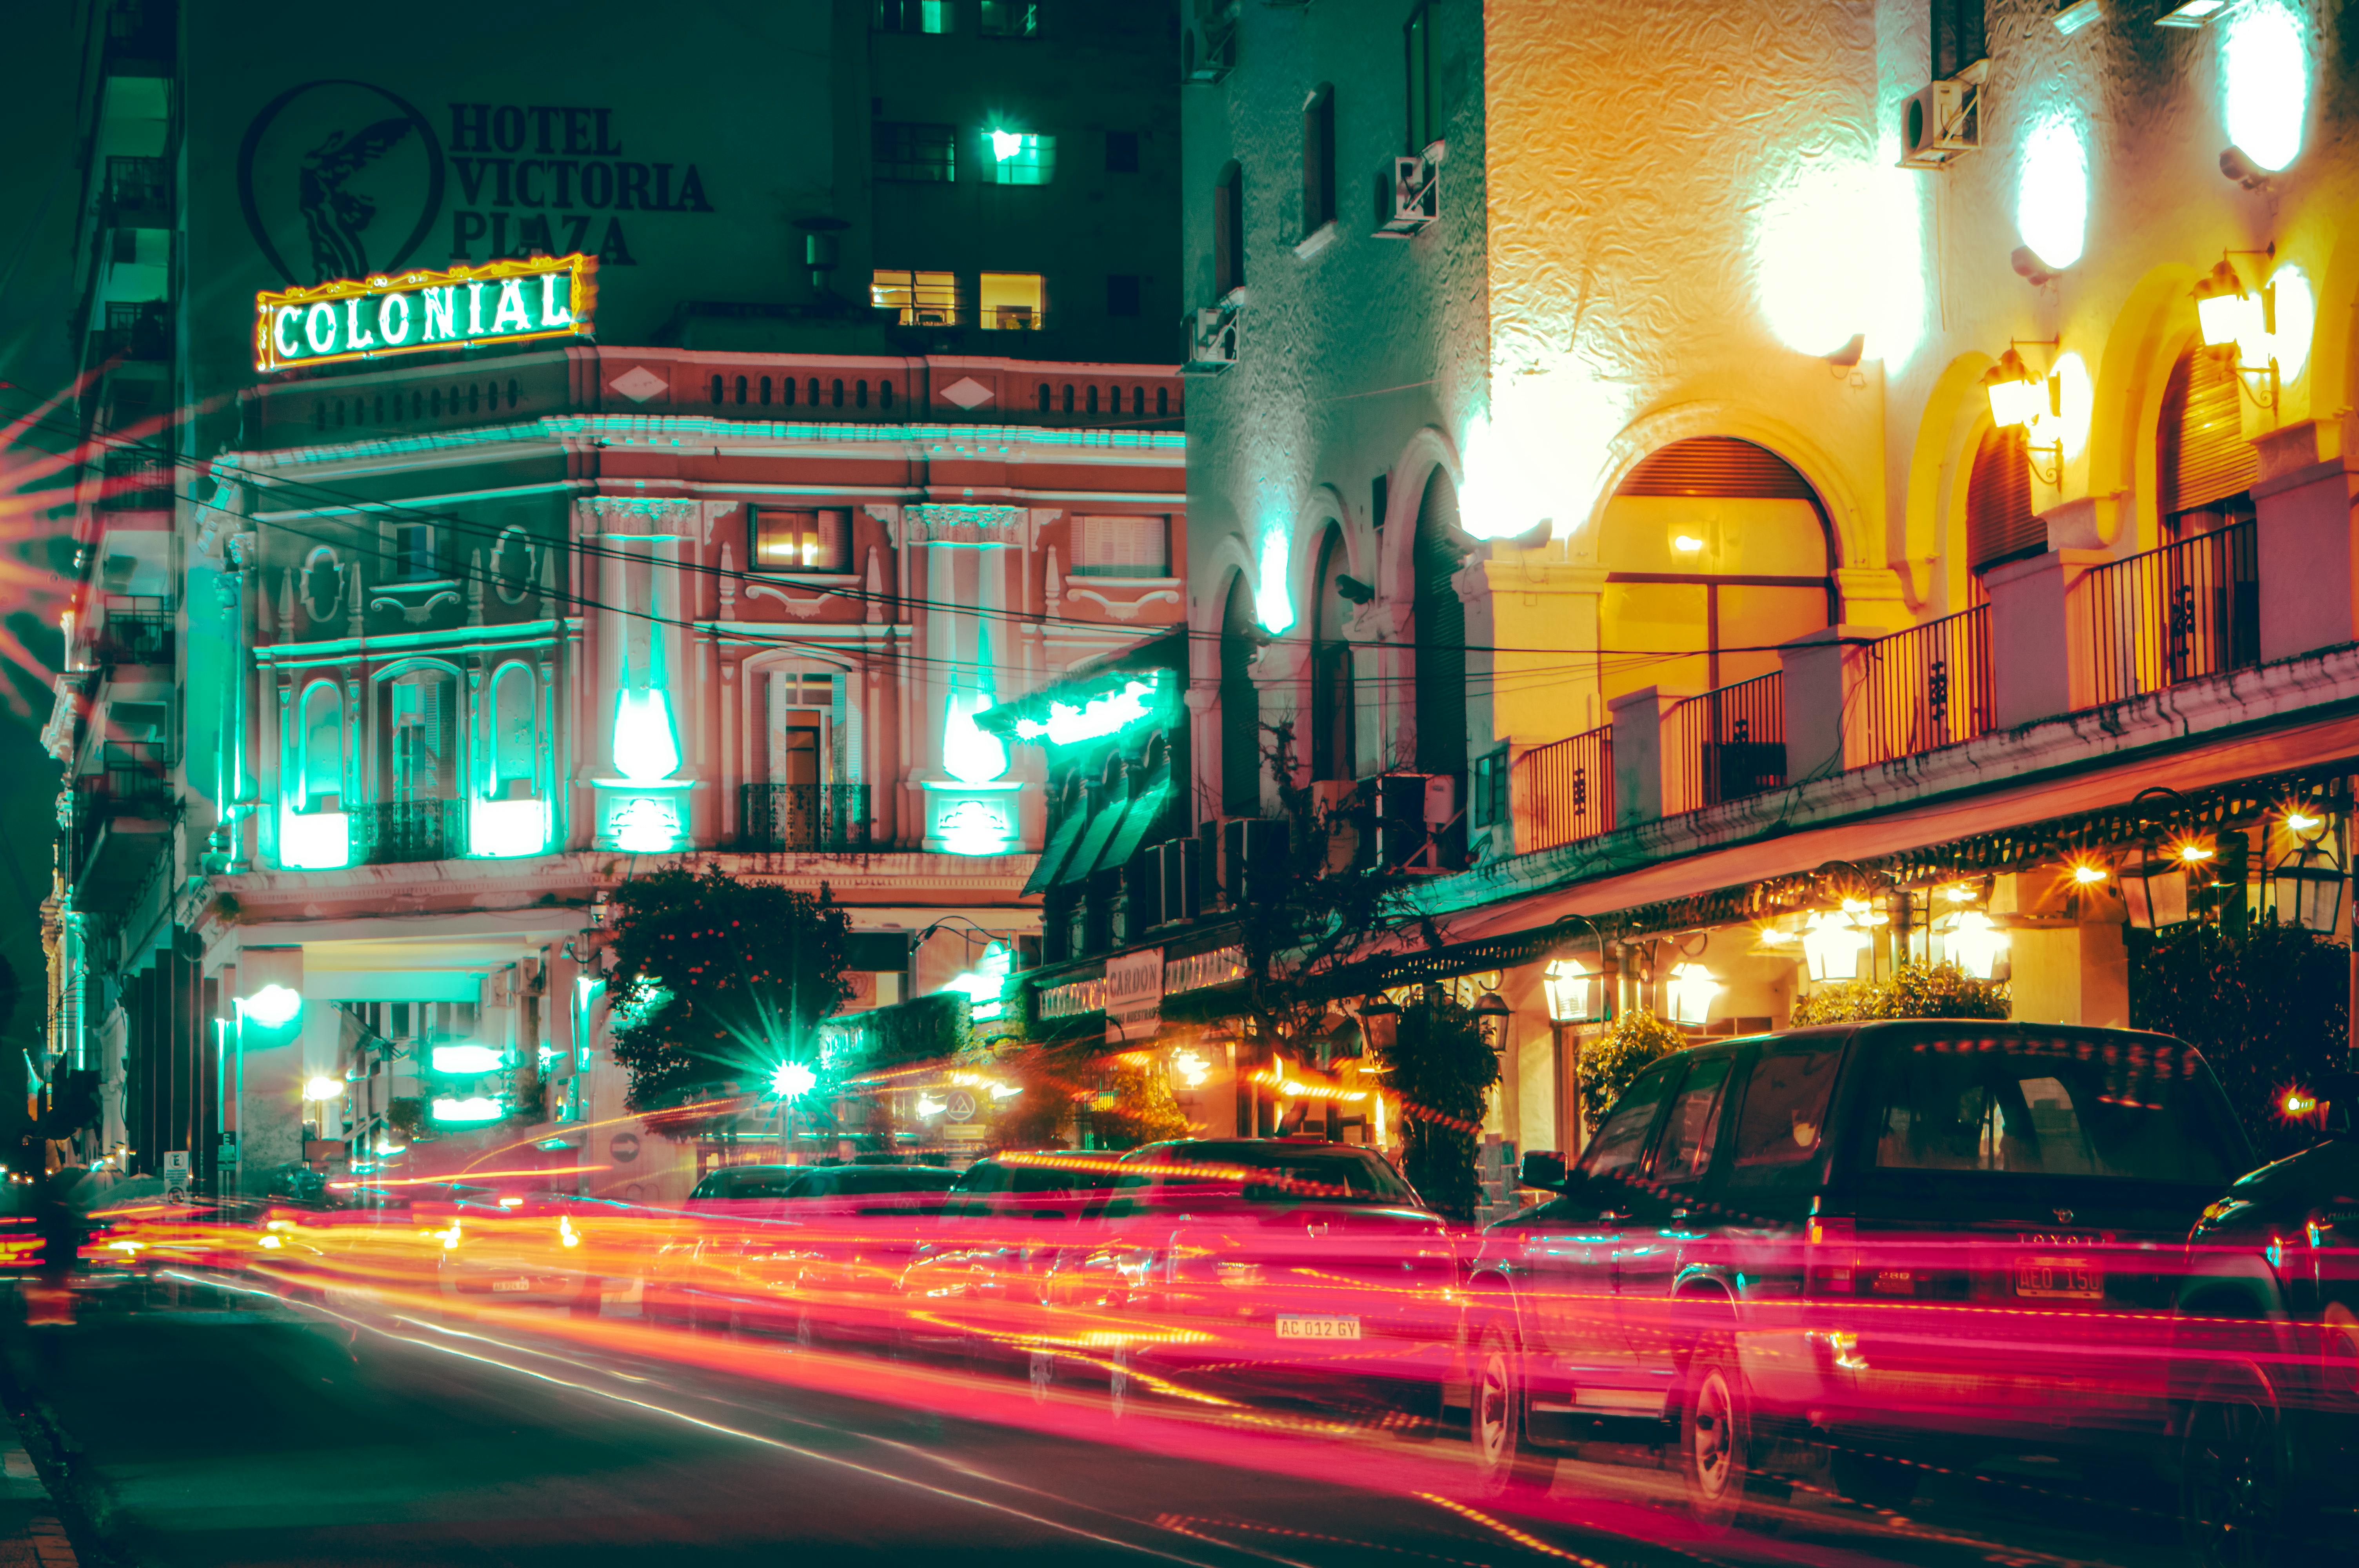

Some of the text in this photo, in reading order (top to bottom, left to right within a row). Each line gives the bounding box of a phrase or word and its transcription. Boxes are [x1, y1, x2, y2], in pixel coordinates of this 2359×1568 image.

[447, 102, 622, 157] HOTEL
[449, 156, 715, 213] VICTORIA
[449, 210, 638, 266] PLAZA
[272, 273, 573, 358] COLONIAL
[1109, 963, 1157, 998] CARDON
[173, 1154, 179, 1166] E
[224, 1134, 230, 1145] E
[1282, 1321, 1355, 1337] AC 012 GY
